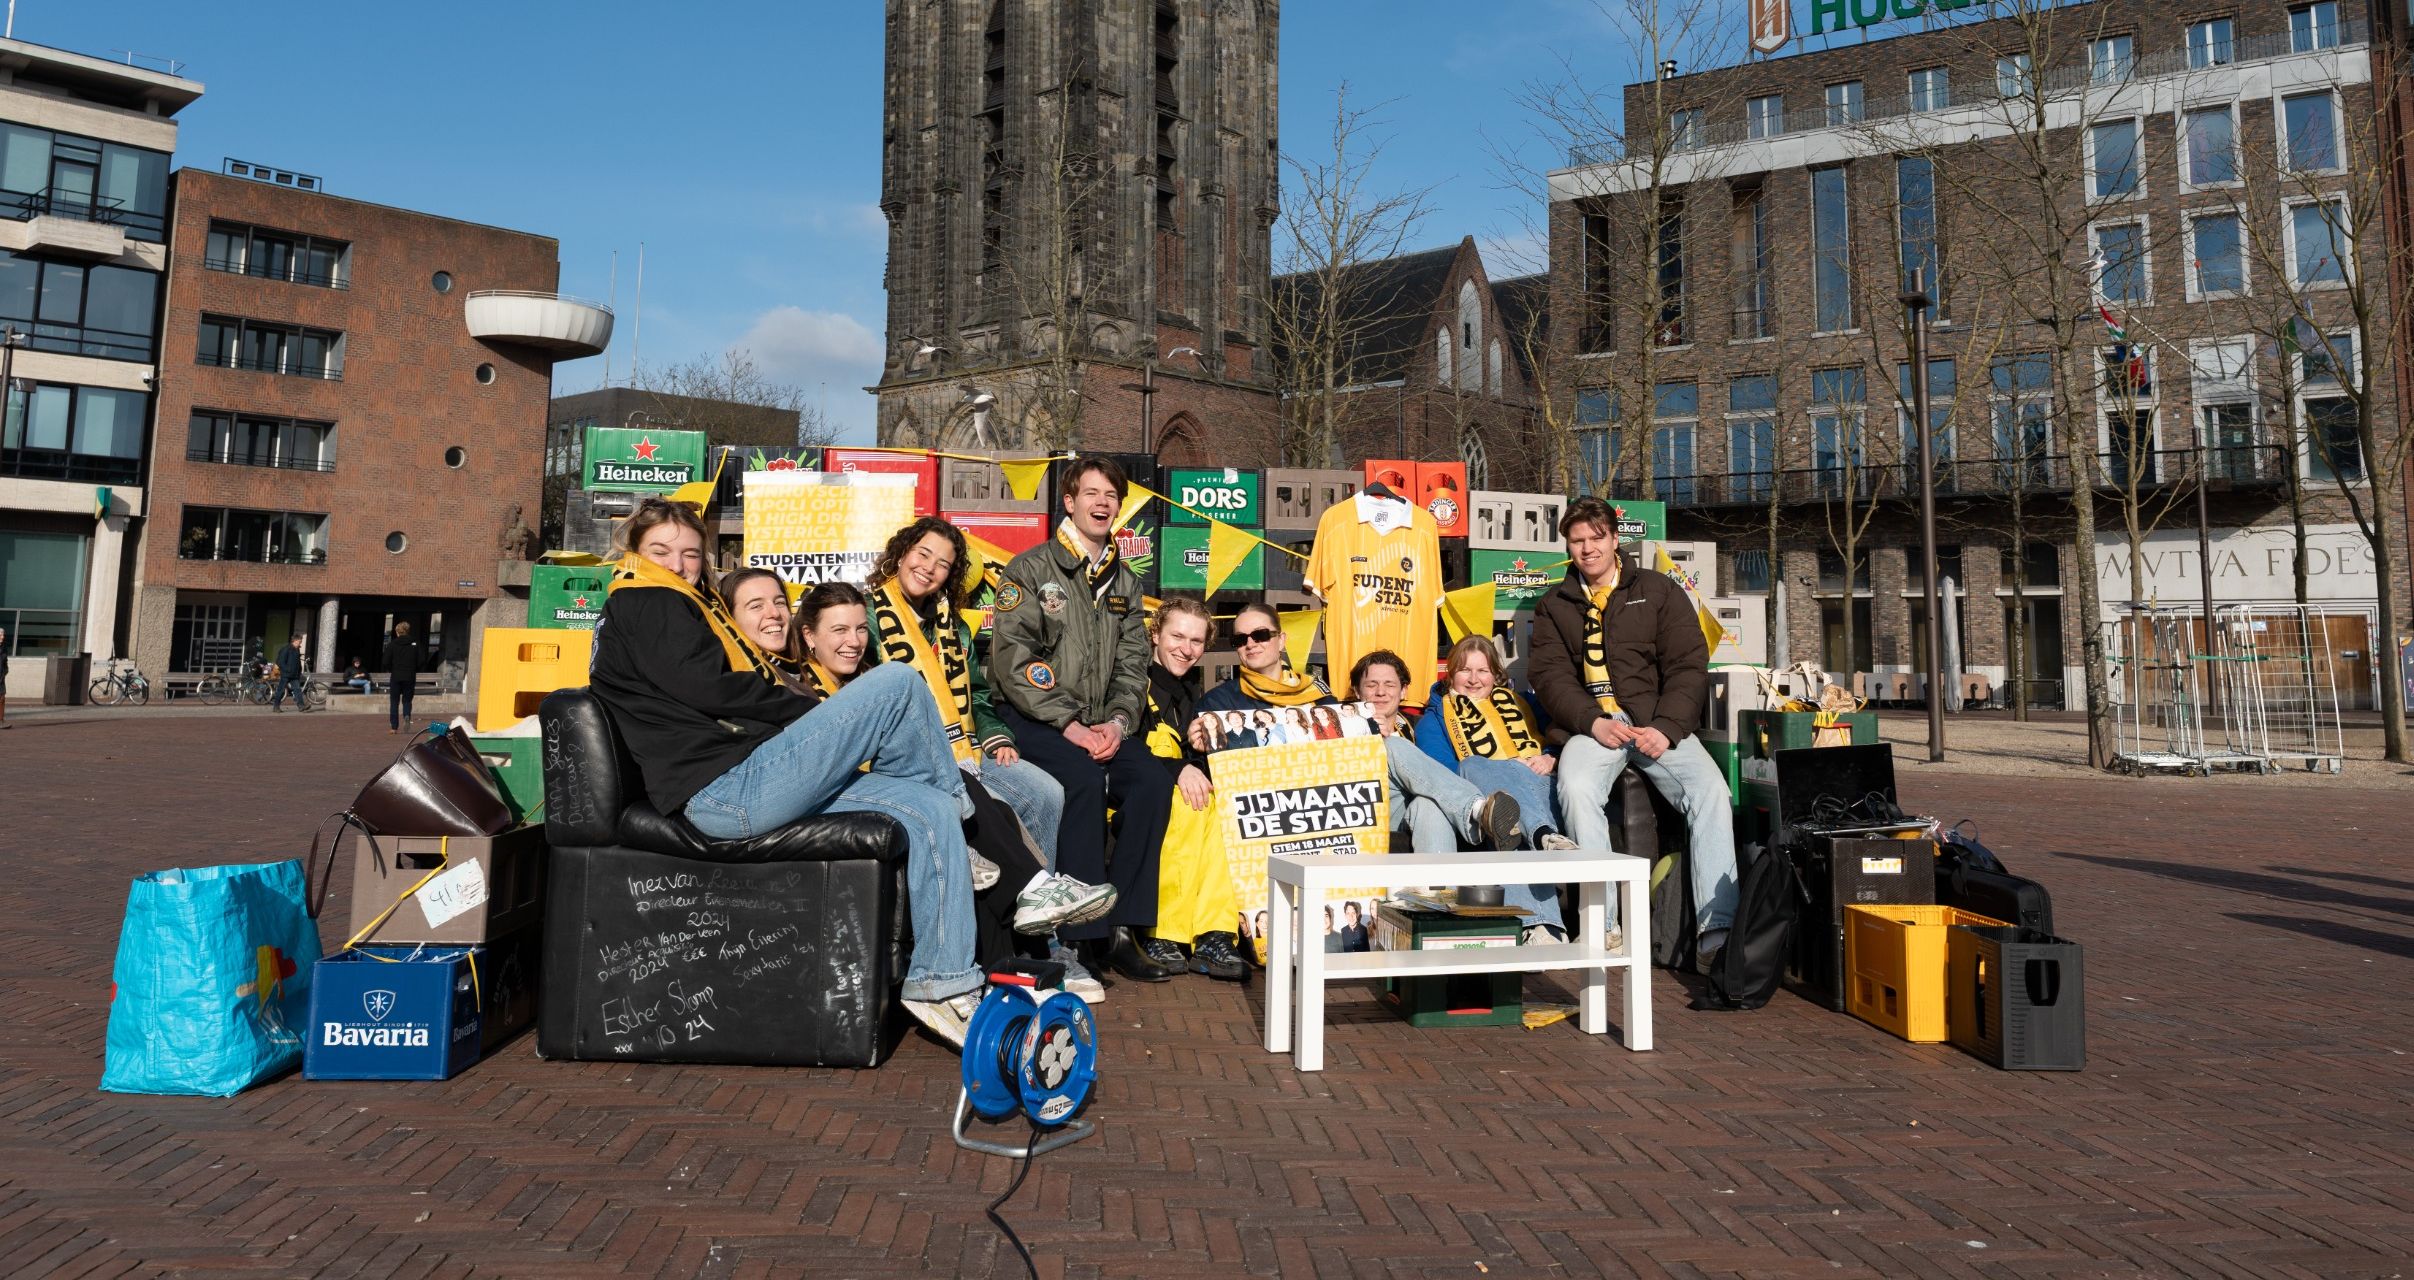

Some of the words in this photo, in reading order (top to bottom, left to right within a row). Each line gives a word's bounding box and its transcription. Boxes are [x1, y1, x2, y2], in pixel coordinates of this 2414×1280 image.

[599, 465, 687, 483] Heineken
[1181, 487, 1247, 509] DORS
[1618, 522, 1644, 534] eken
[1495, 574, 1547, 586] Heineken
[555, 610, 600, 620] Heineke
[1449, 717, 1462, 739] since
[1454, 694, 1498, 759] STAD
[1285, 750, 1327, 767] LEVI
[1235, 792, 1276, 816] JIJ
[1276, 781, 1380, 812] MAAKT
[1242, 815, 1284, 838] DE
[1289, 804, 1374, 834] STAD!
[1272, 842, 1301, 854] STEM
[1303, 839, 1313, 850] 18
[1316, 834, 1353, 848] MAART
[687, 911, 730, 931] 2024
[628, 956, 670, 984] 2024
[323, 1022, 429, 1046] Bavaria
